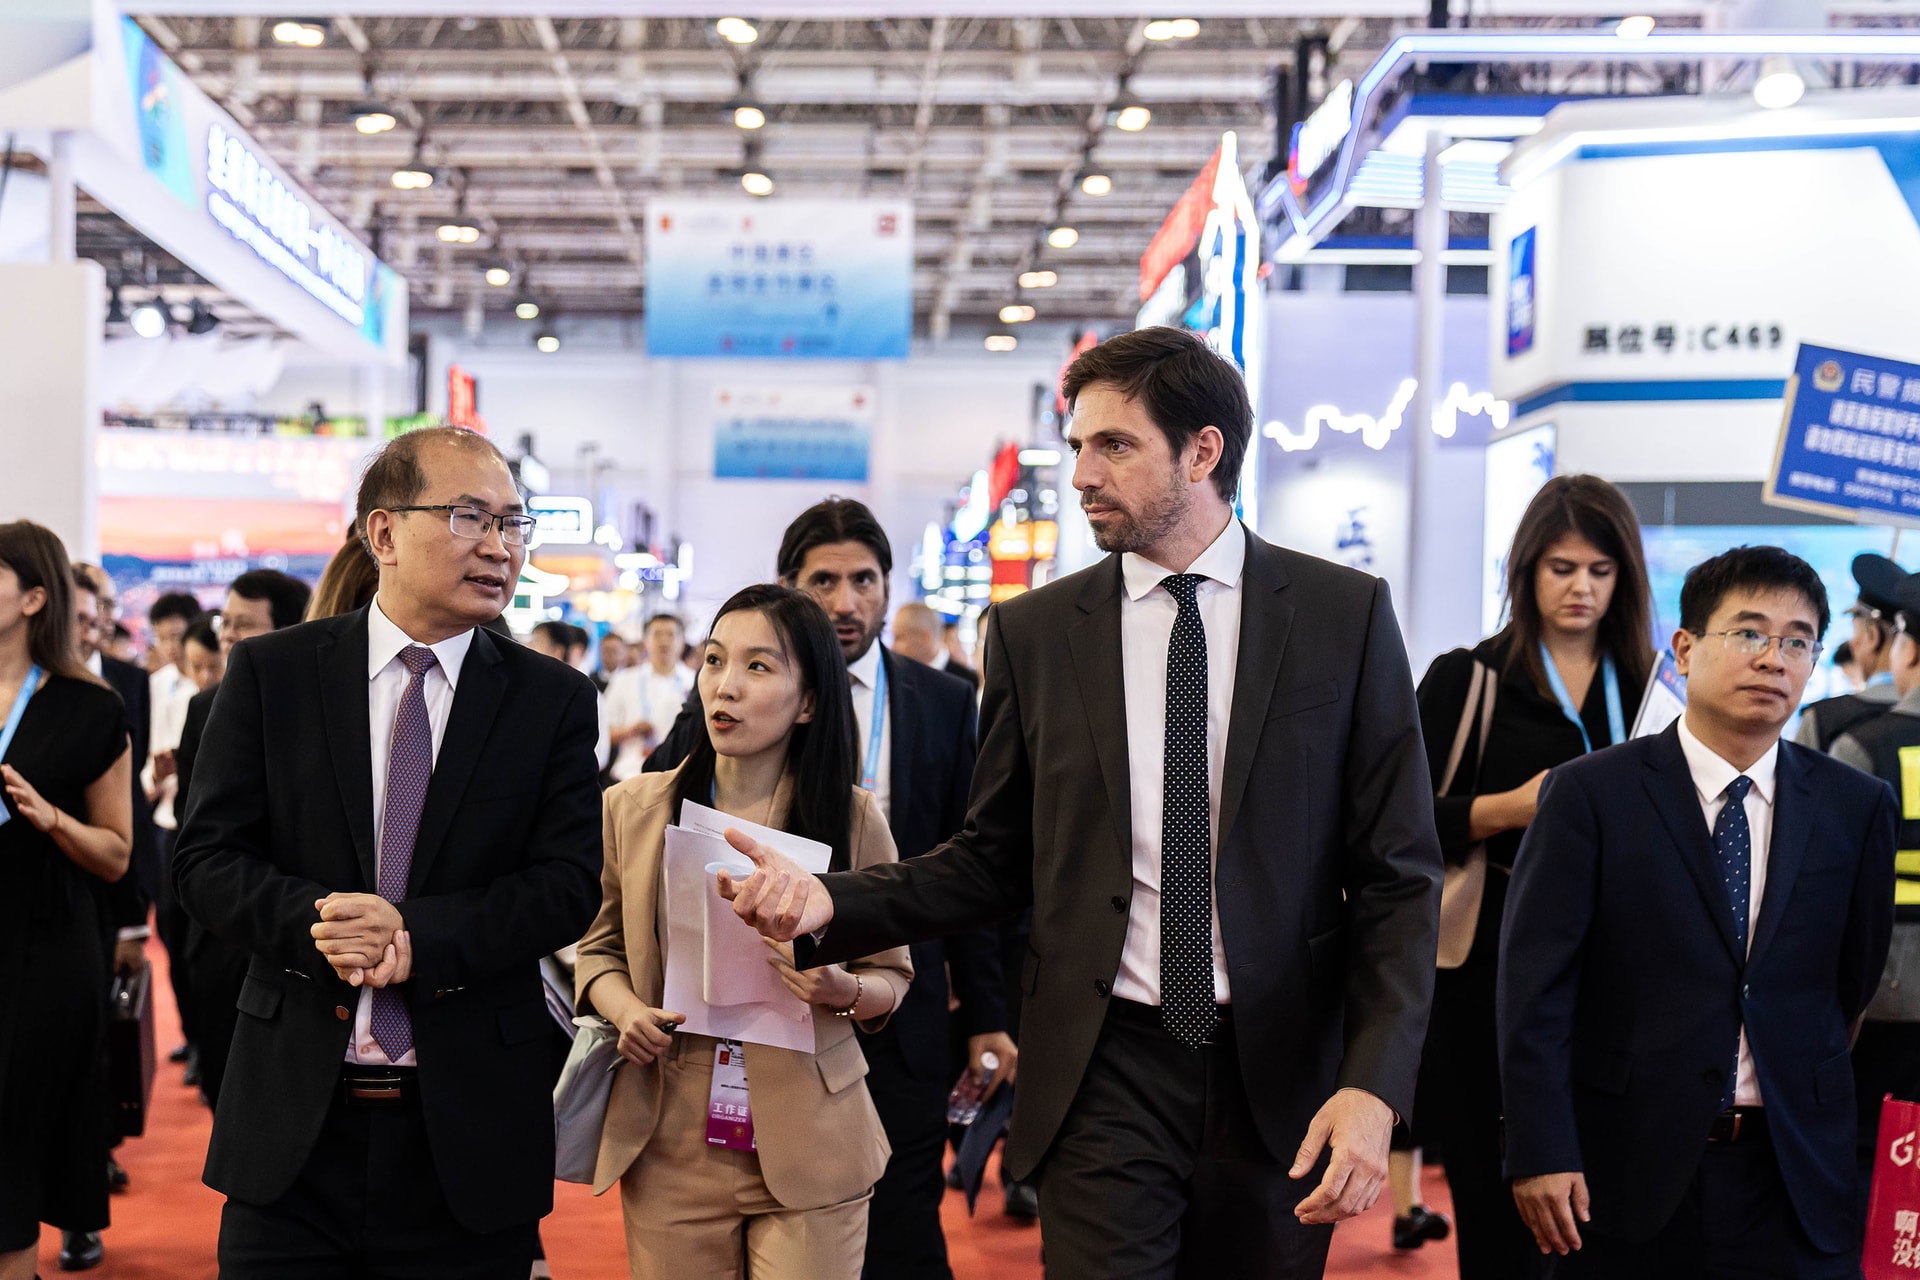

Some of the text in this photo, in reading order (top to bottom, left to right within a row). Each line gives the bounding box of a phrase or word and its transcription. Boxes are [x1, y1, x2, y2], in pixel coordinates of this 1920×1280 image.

[711, 1113, 747, 1123] ORGANIZER
[712, 1102, 749, 1117] 工作证
[1889, 1130, 1920, 1169] G
[1894, 1209, 1920, 1239] 啊
[1891, 1237, 1920, 1270] 没
